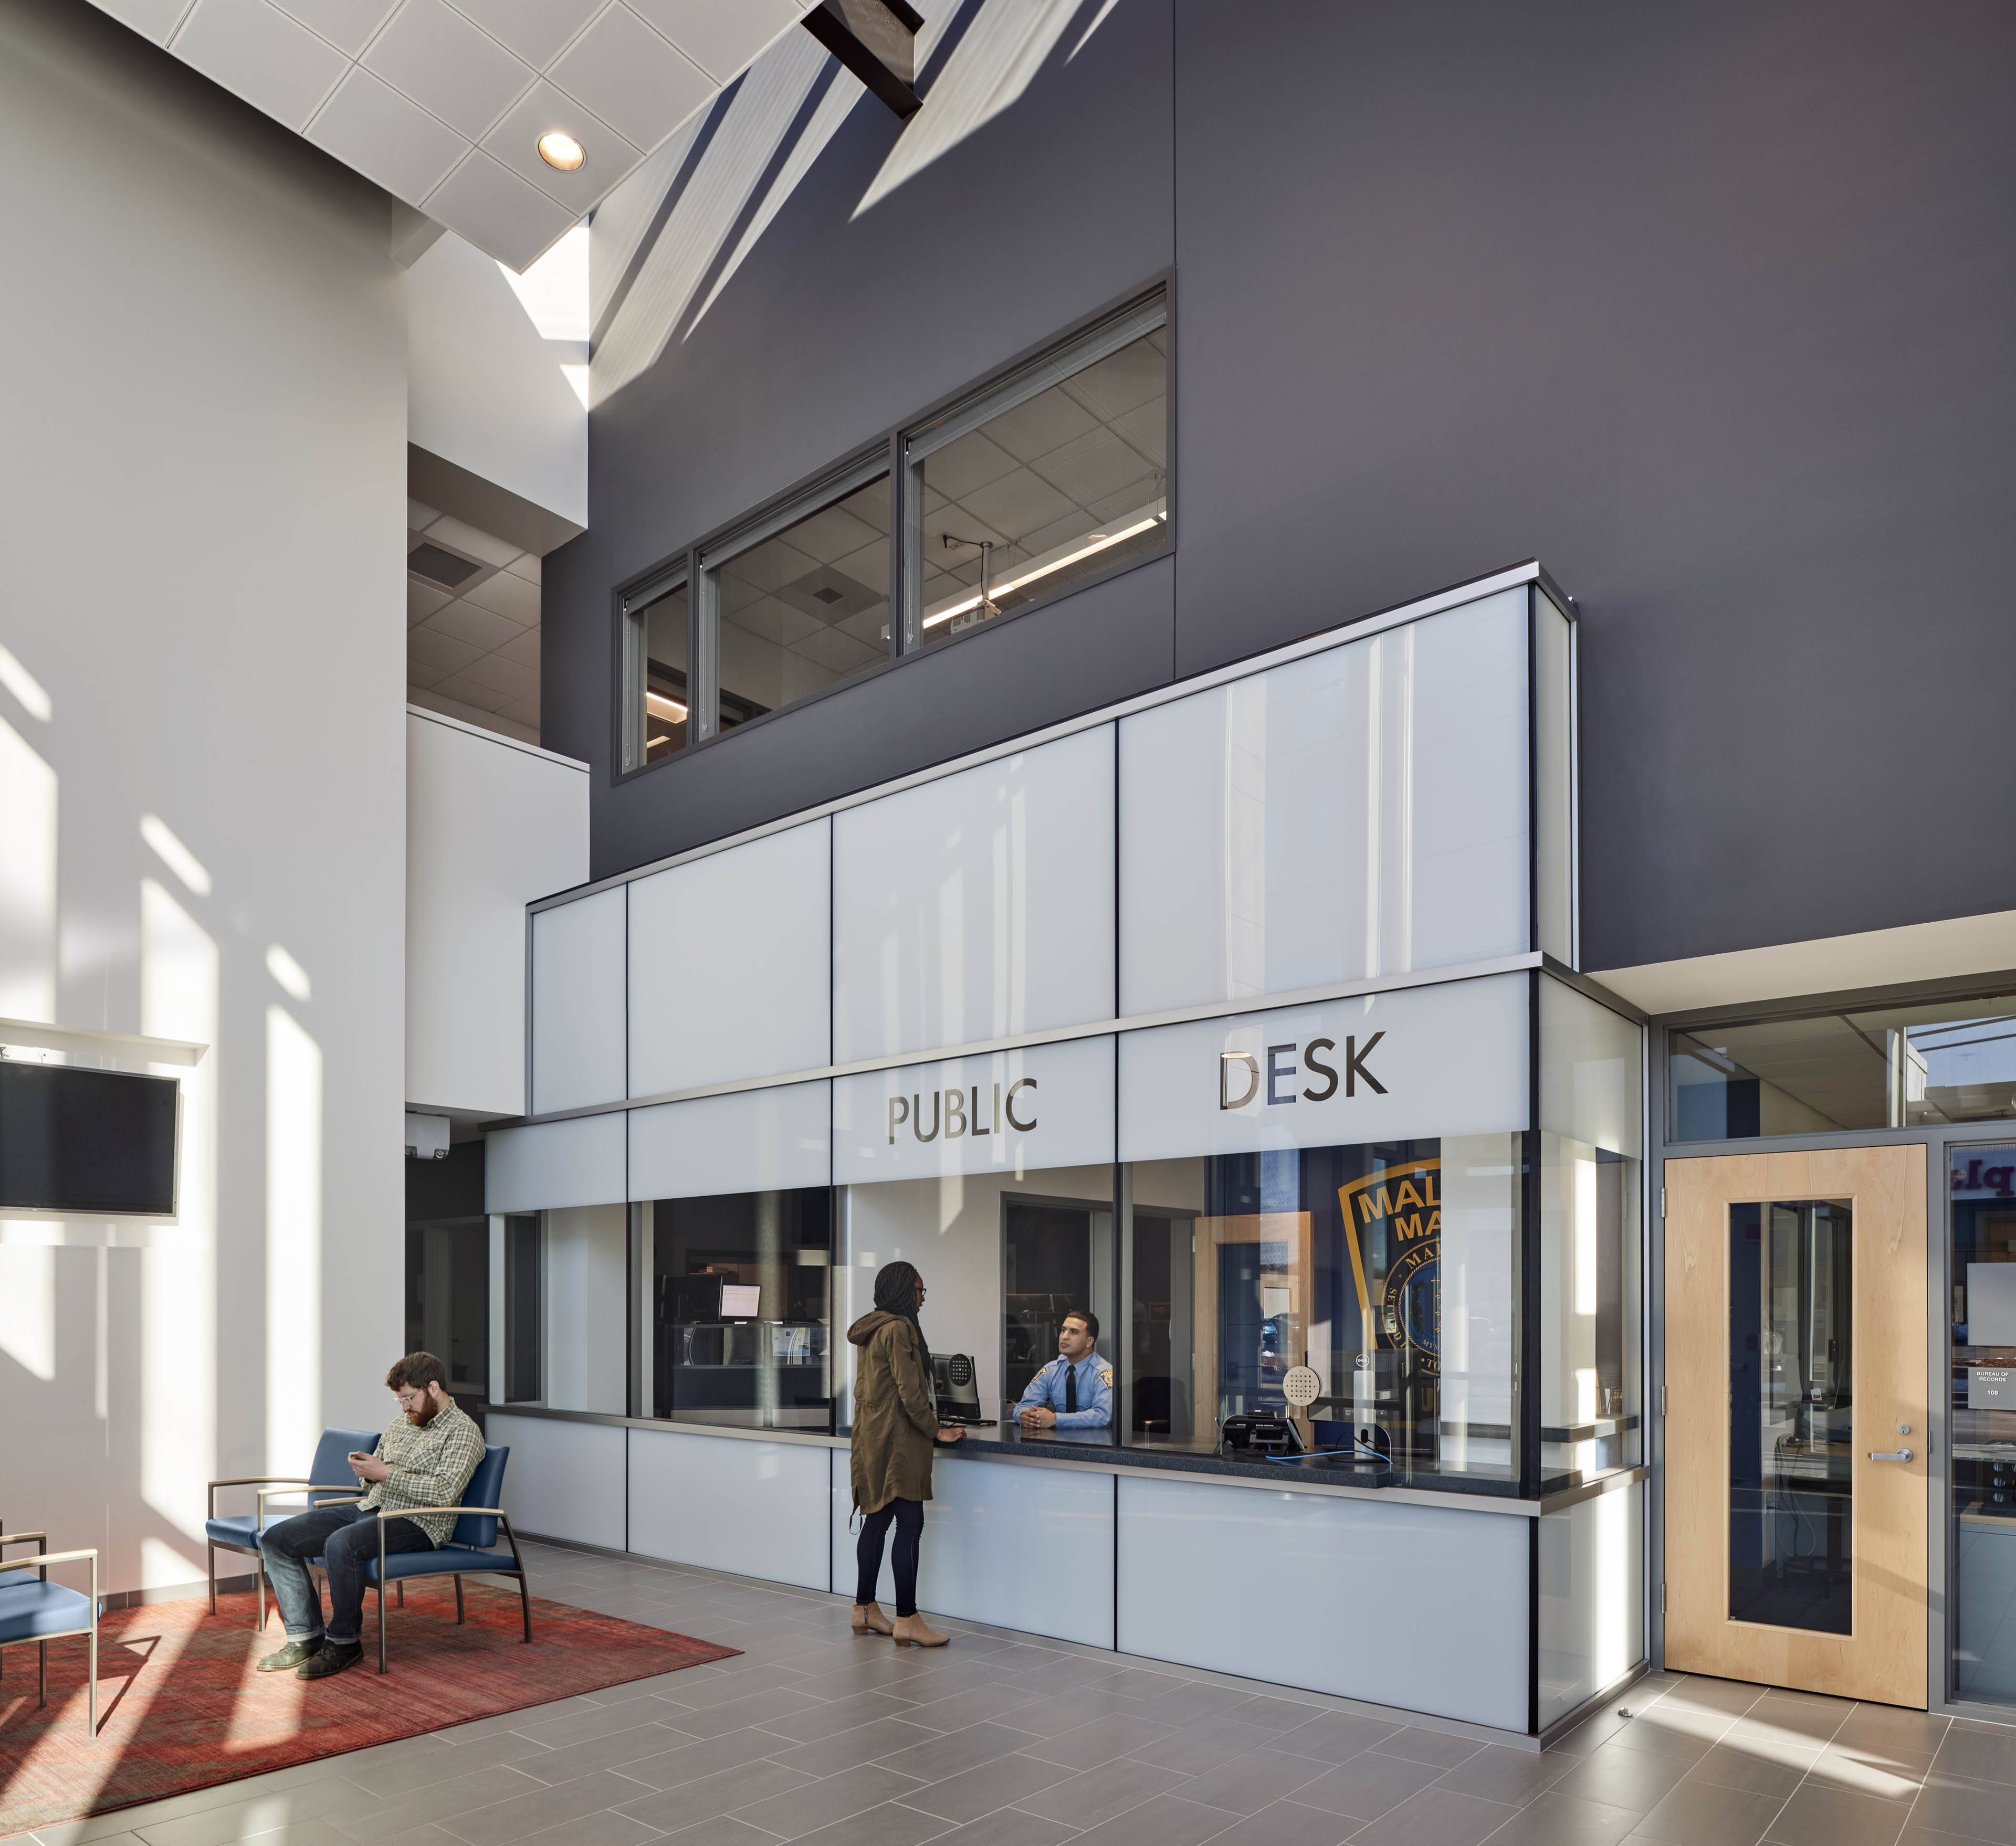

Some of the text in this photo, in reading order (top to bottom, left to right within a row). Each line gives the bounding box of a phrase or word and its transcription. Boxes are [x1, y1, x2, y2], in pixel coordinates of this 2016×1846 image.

[889, 1031, 1389, 1145] PUBLIC DESK
[1357, 1176, 1441, 1224] MAL
[1394, 1210, 1441, 1241] MA
